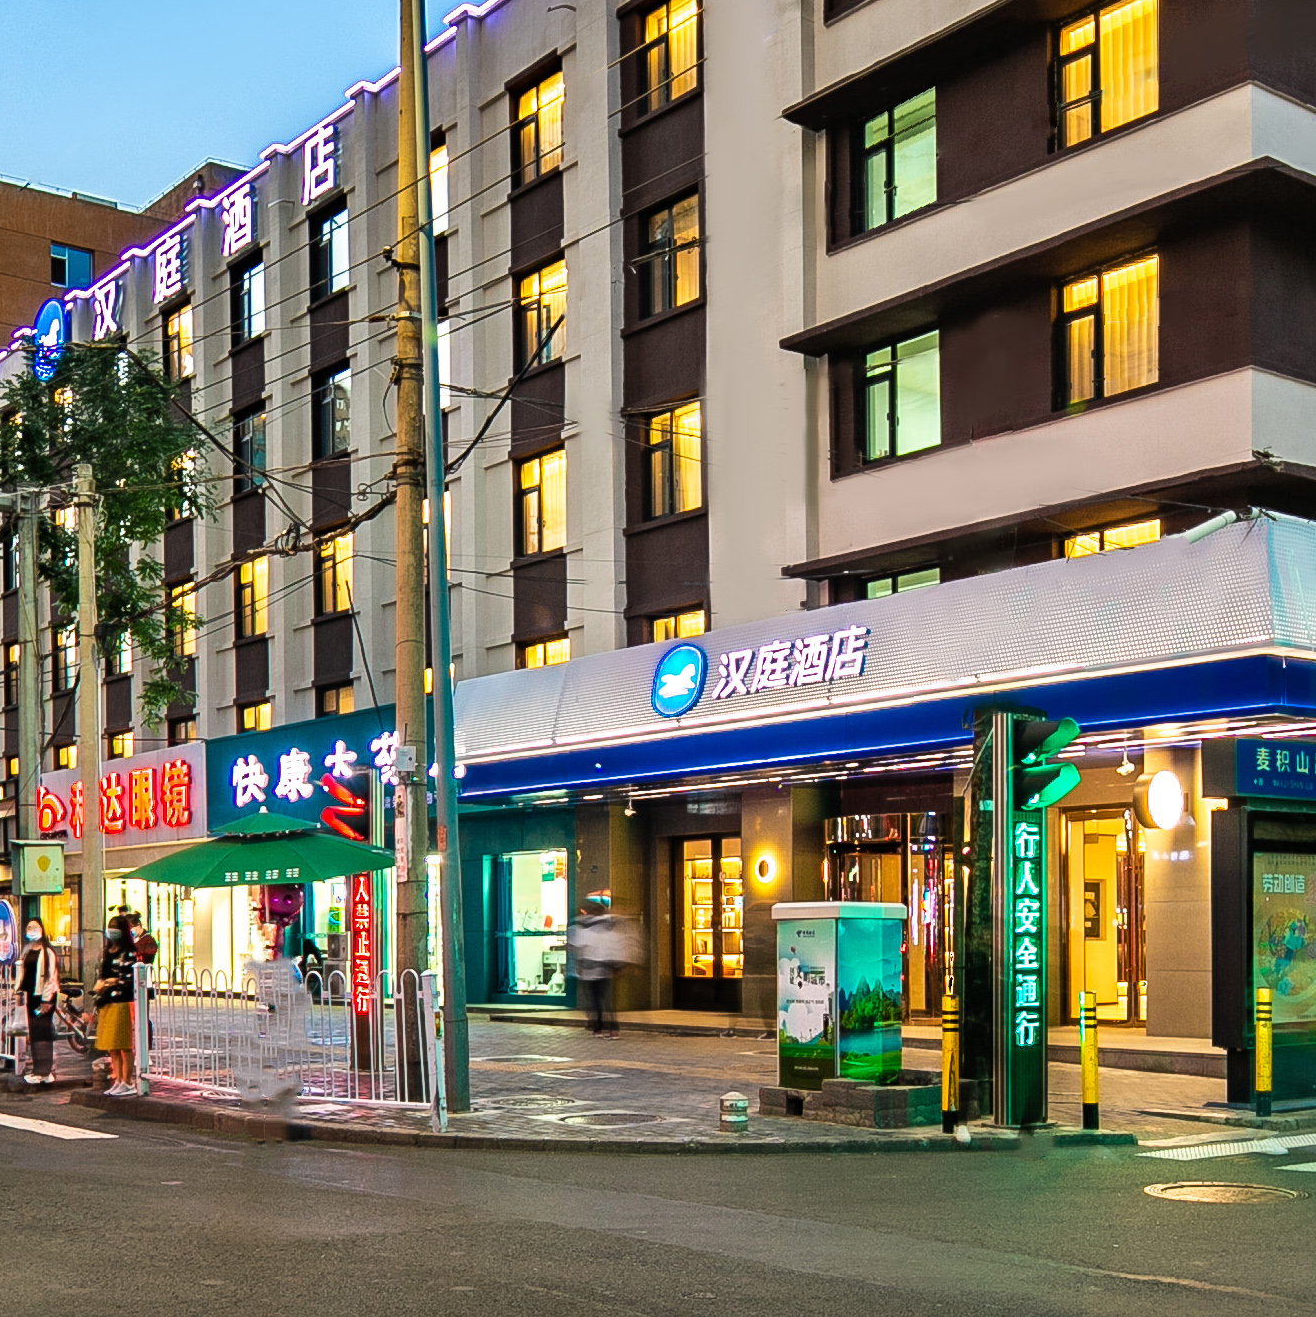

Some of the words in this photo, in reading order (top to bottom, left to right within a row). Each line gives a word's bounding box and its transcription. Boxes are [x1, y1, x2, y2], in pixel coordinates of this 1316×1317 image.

[94, 124, 335, 341] 汉庭酒店
[711, 624, 867, 699] 汉庭酒店
[231, 730, 467, 808] 快康大药
[1262, 873, 1305, 894] 劳动创造
[1015, 822, 1040, 1046] 行人安全通行
